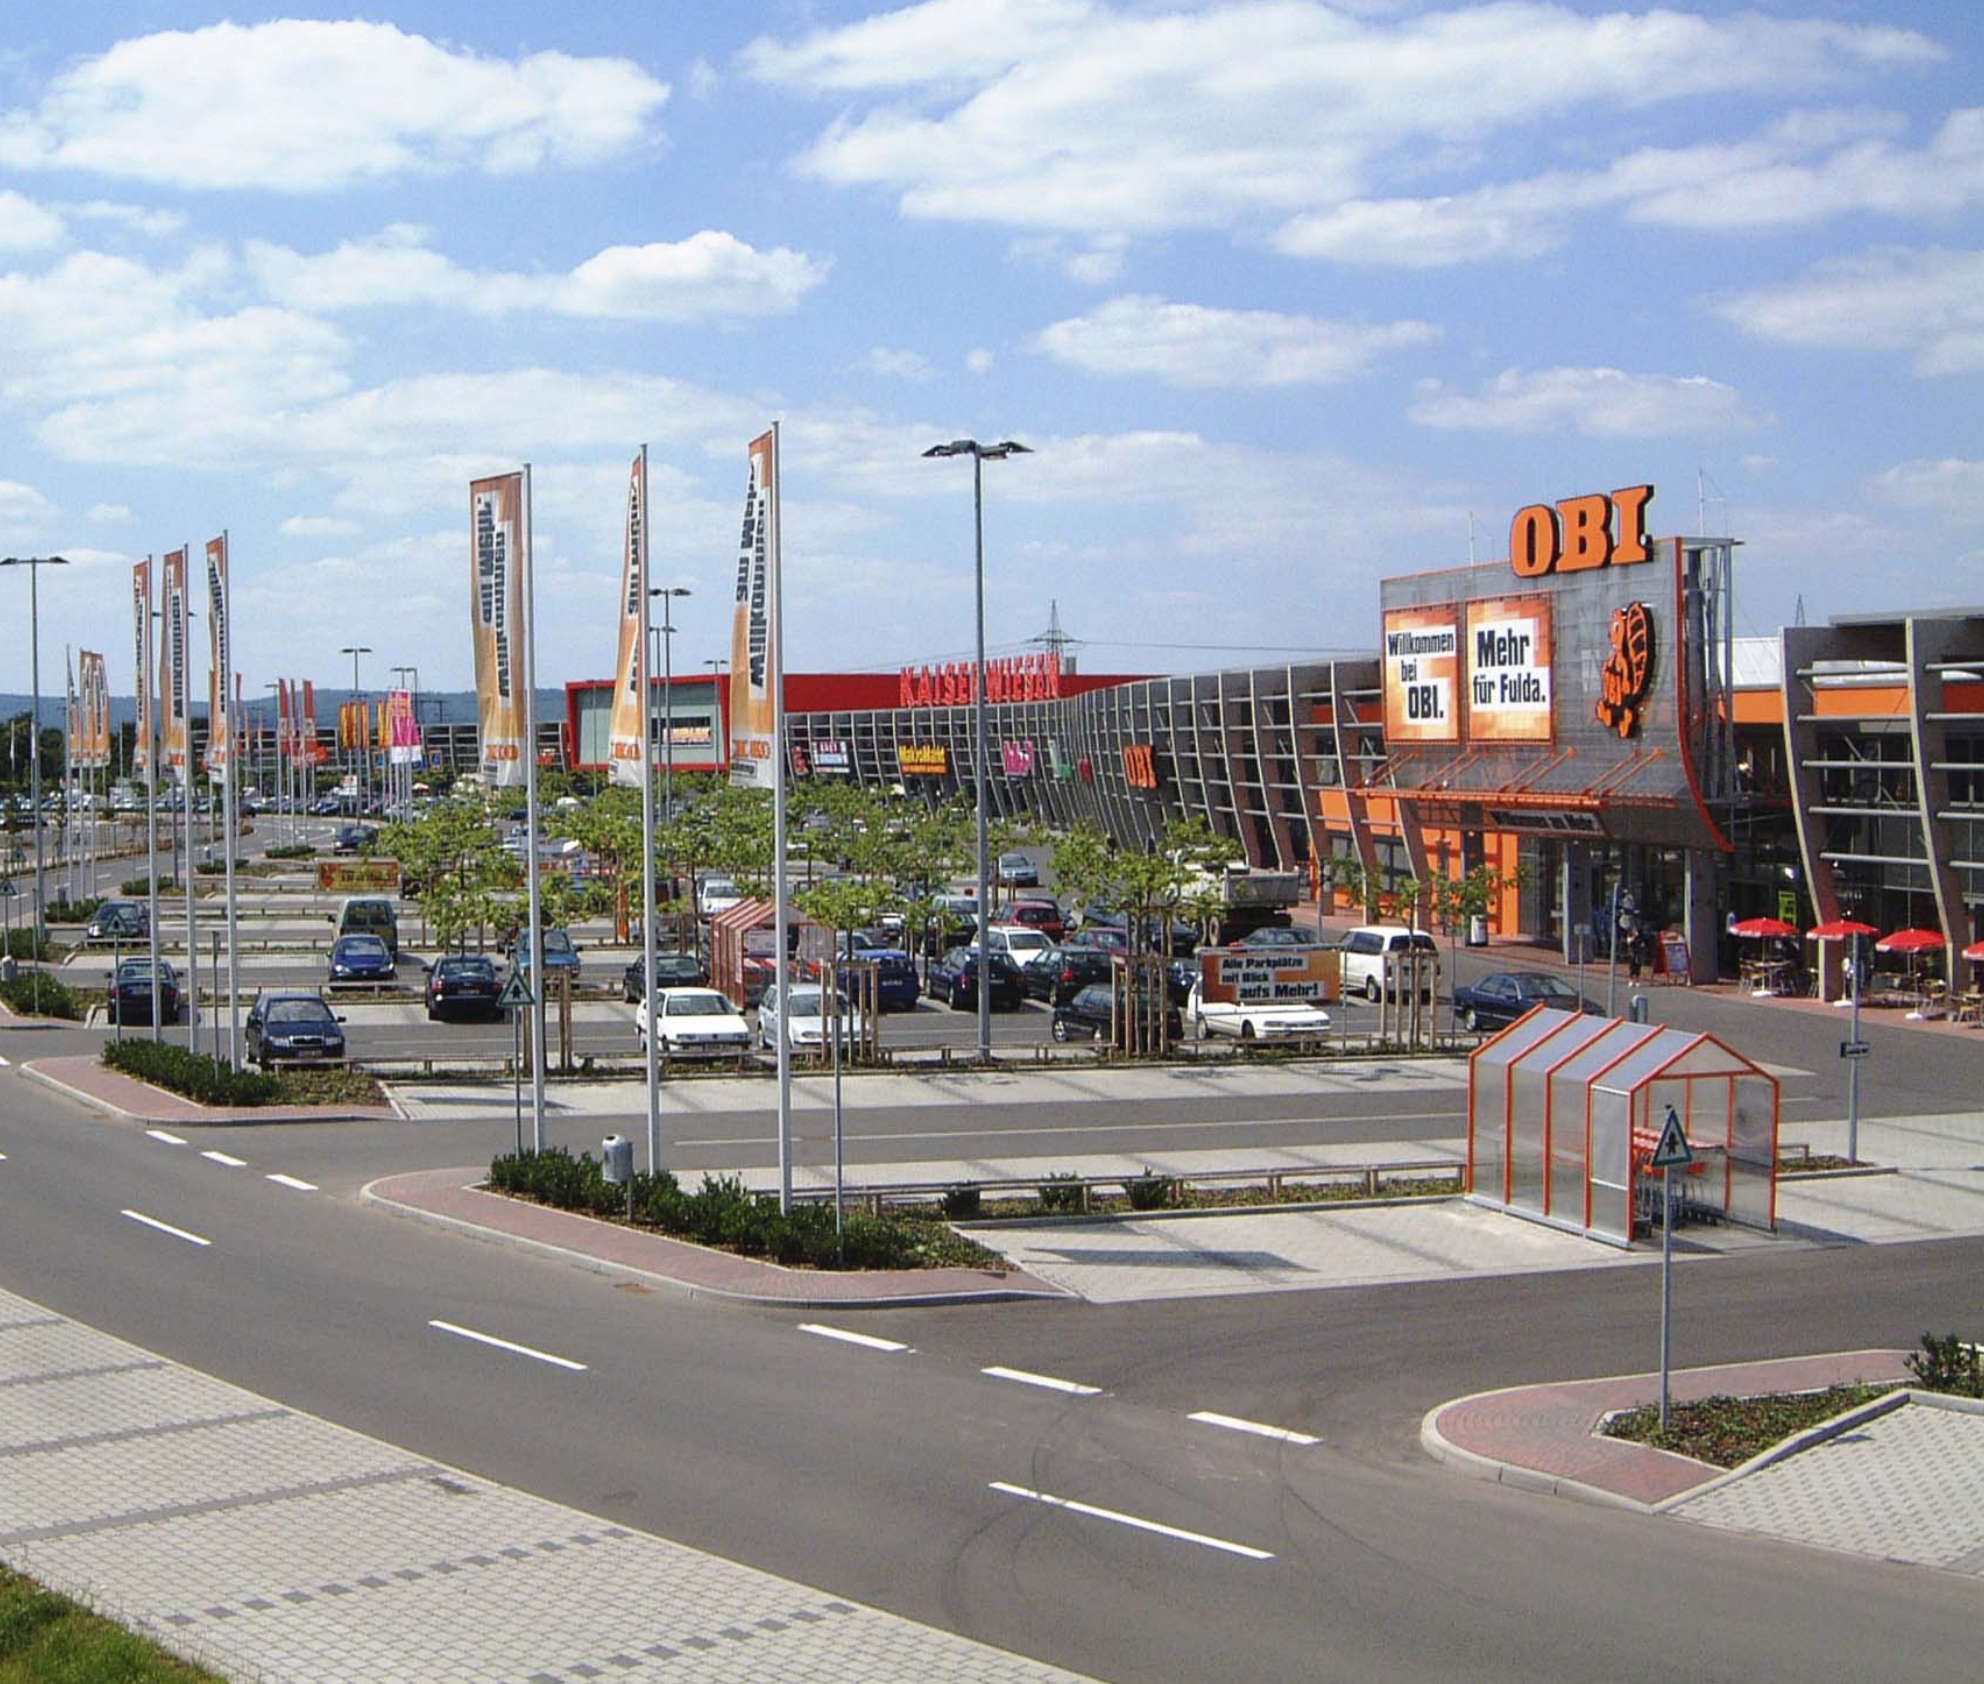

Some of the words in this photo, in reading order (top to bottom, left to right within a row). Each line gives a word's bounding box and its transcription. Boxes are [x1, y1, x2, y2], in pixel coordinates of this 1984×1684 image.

[1387, 632, 1454, 656] Willkommen
[1477, 628, 1530, 668] Mehr
[1401, 658, 1417, 682] bei
[1473, 674, 1496, 704] für
[1500, 672, 1546, 703] Fulda.
[1408, 685, 1444, 719] OBI.
[1124, 744, 1158, 789] OBI
[1222, 958, 1243, 969] Alle
[1246, 957, 1304, 970] Parkplätze
[1222, 973, 1239, 983] mit
[1242, 972, 1269, 983] Blick
[1240, 985, 1270, 998] aufs
[1274, 982, 1319, 998] Mehr!
